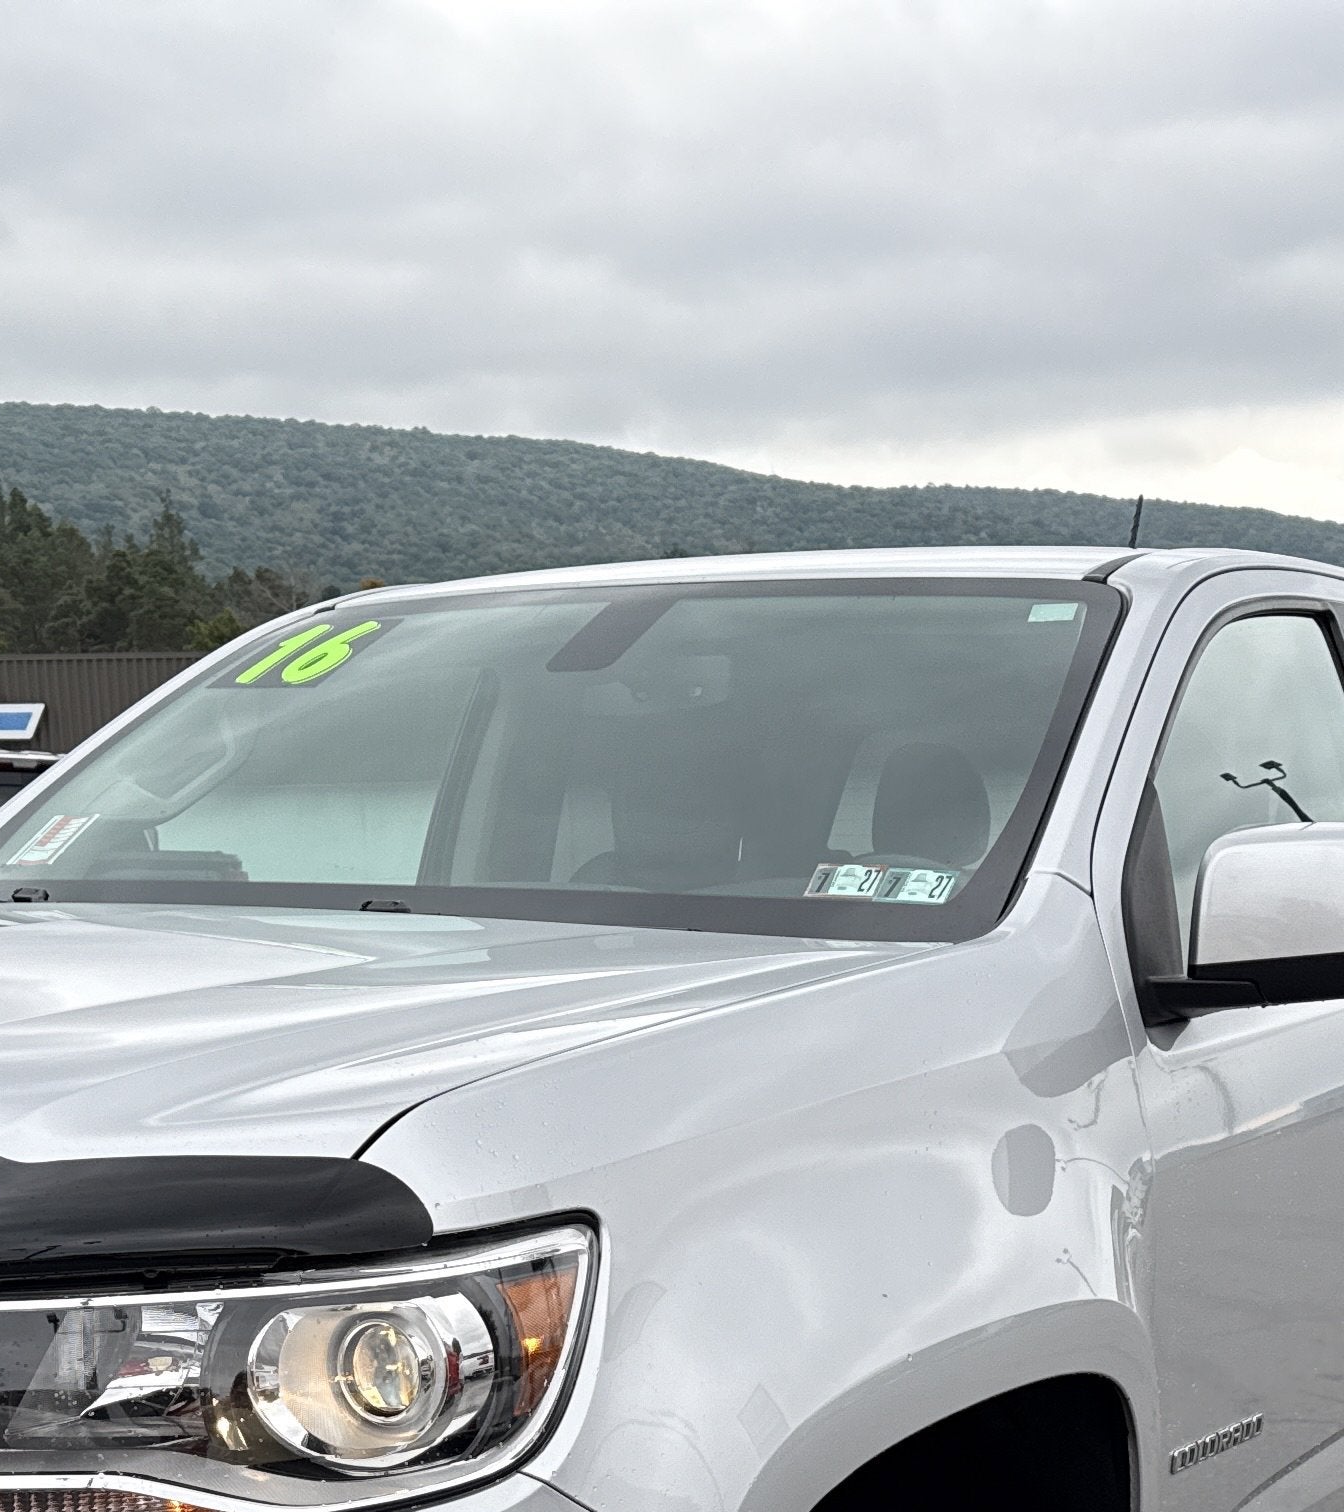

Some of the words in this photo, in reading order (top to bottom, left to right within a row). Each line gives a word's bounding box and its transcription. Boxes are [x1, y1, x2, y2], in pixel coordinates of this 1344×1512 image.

[235, 620, 381, 685] 16
[857, 869, 882, 894] 27
[928, 875, 953, 900] 27
[1169, 1412, 1264, 1475] COLORADO
